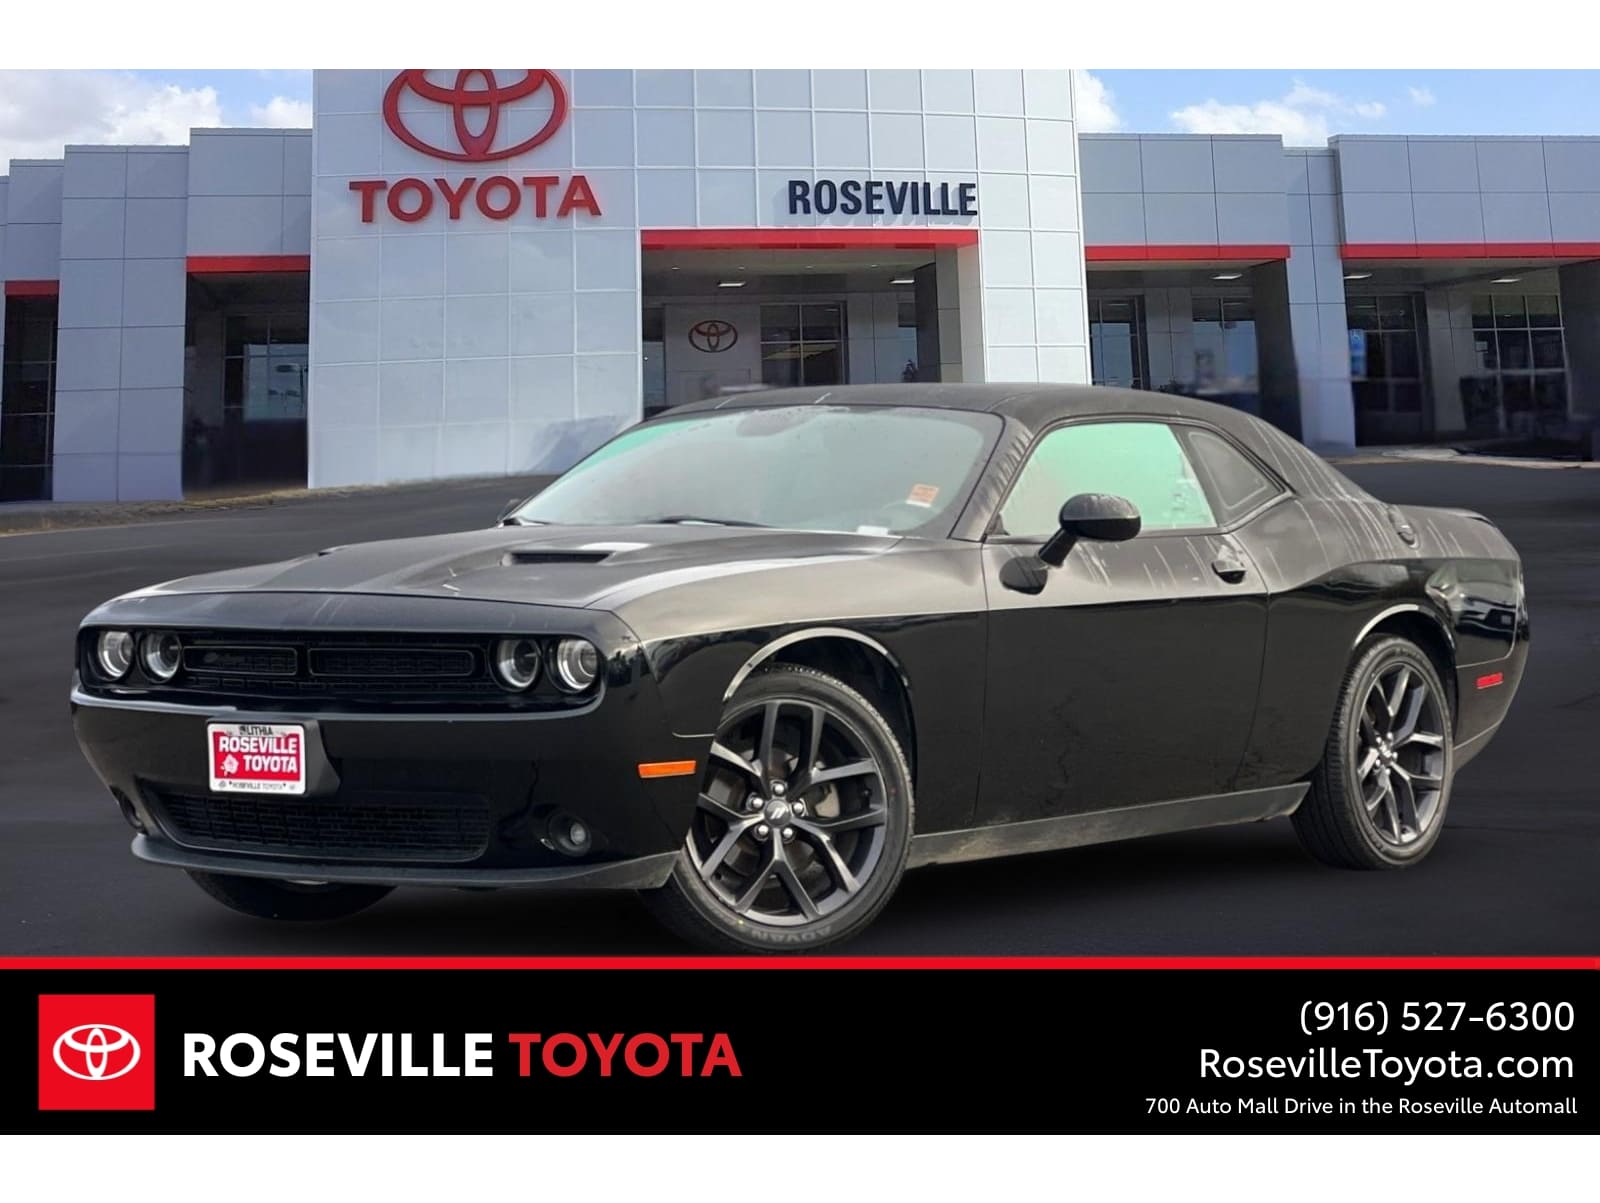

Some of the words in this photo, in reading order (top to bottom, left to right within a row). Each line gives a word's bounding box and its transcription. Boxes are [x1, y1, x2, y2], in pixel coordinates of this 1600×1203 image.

[349, 176, 601, 223] TOYOTA
[788, 179, 979, 217] ROSEVILLE
[247, 725, 274, 736] LITHIA
[218, 736, 298, 754] ROSEVILLE
[243, 754, 298, 773] TOYOTA
